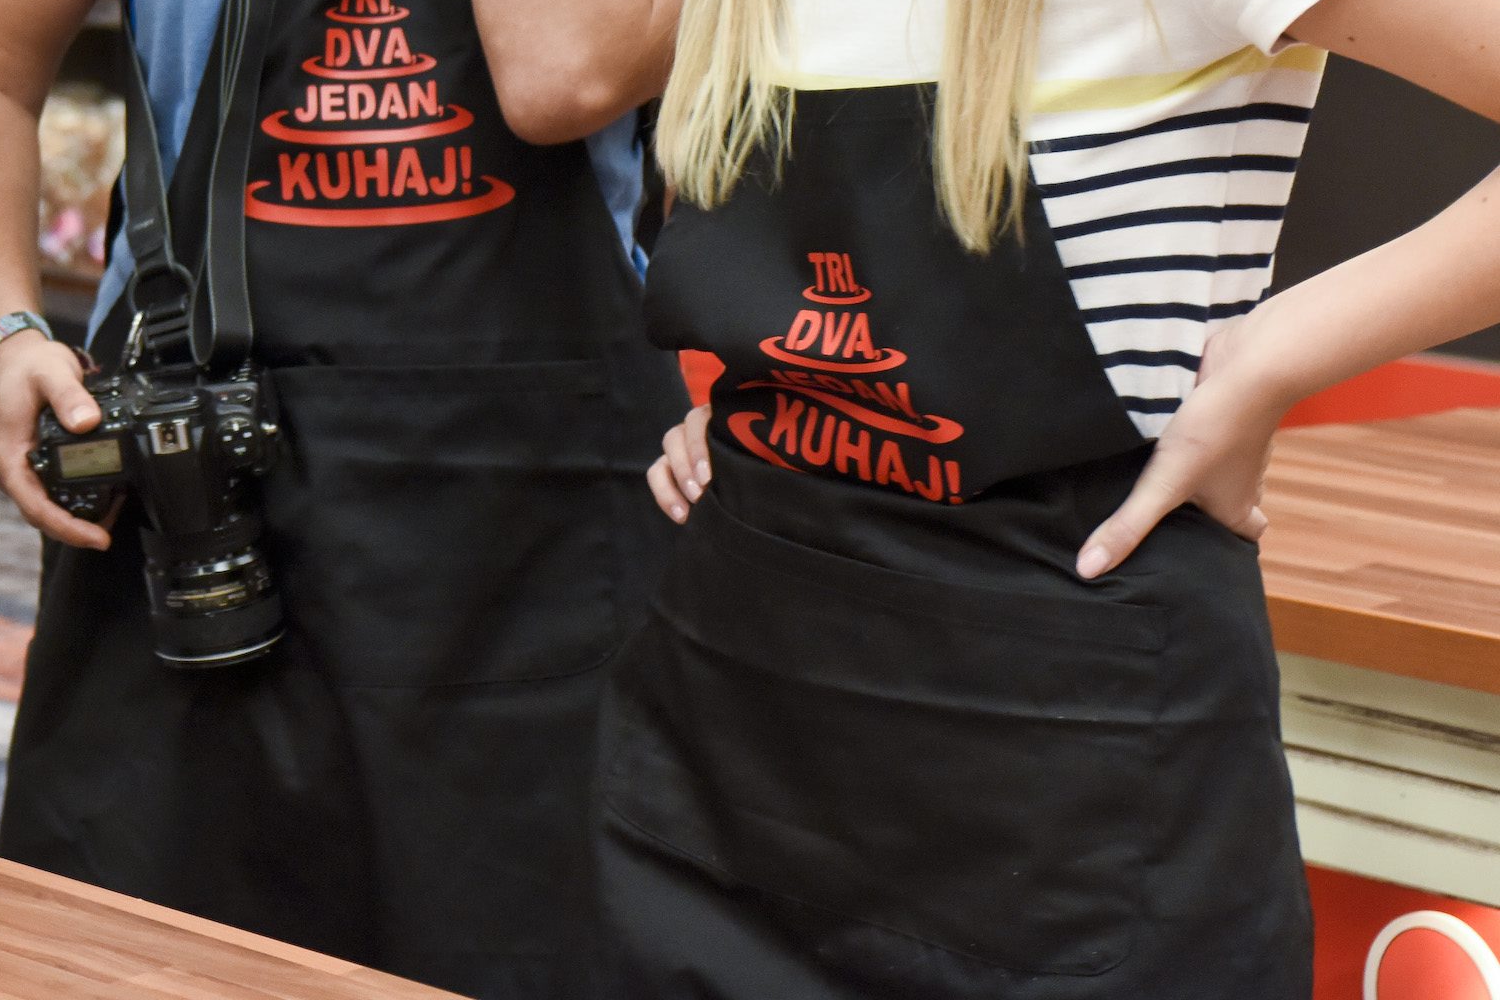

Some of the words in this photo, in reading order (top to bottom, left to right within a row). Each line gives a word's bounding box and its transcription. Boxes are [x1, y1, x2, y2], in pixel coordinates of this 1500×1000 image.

[324, 26, 417, 69] DVA,
[294, 79, 444, 123] JEDAN,
[277, 145, 472, 201] KUHAJ!
[784, 309, 882, 361] DVA,
[768, 393, 965, 505] KUHAJ!
